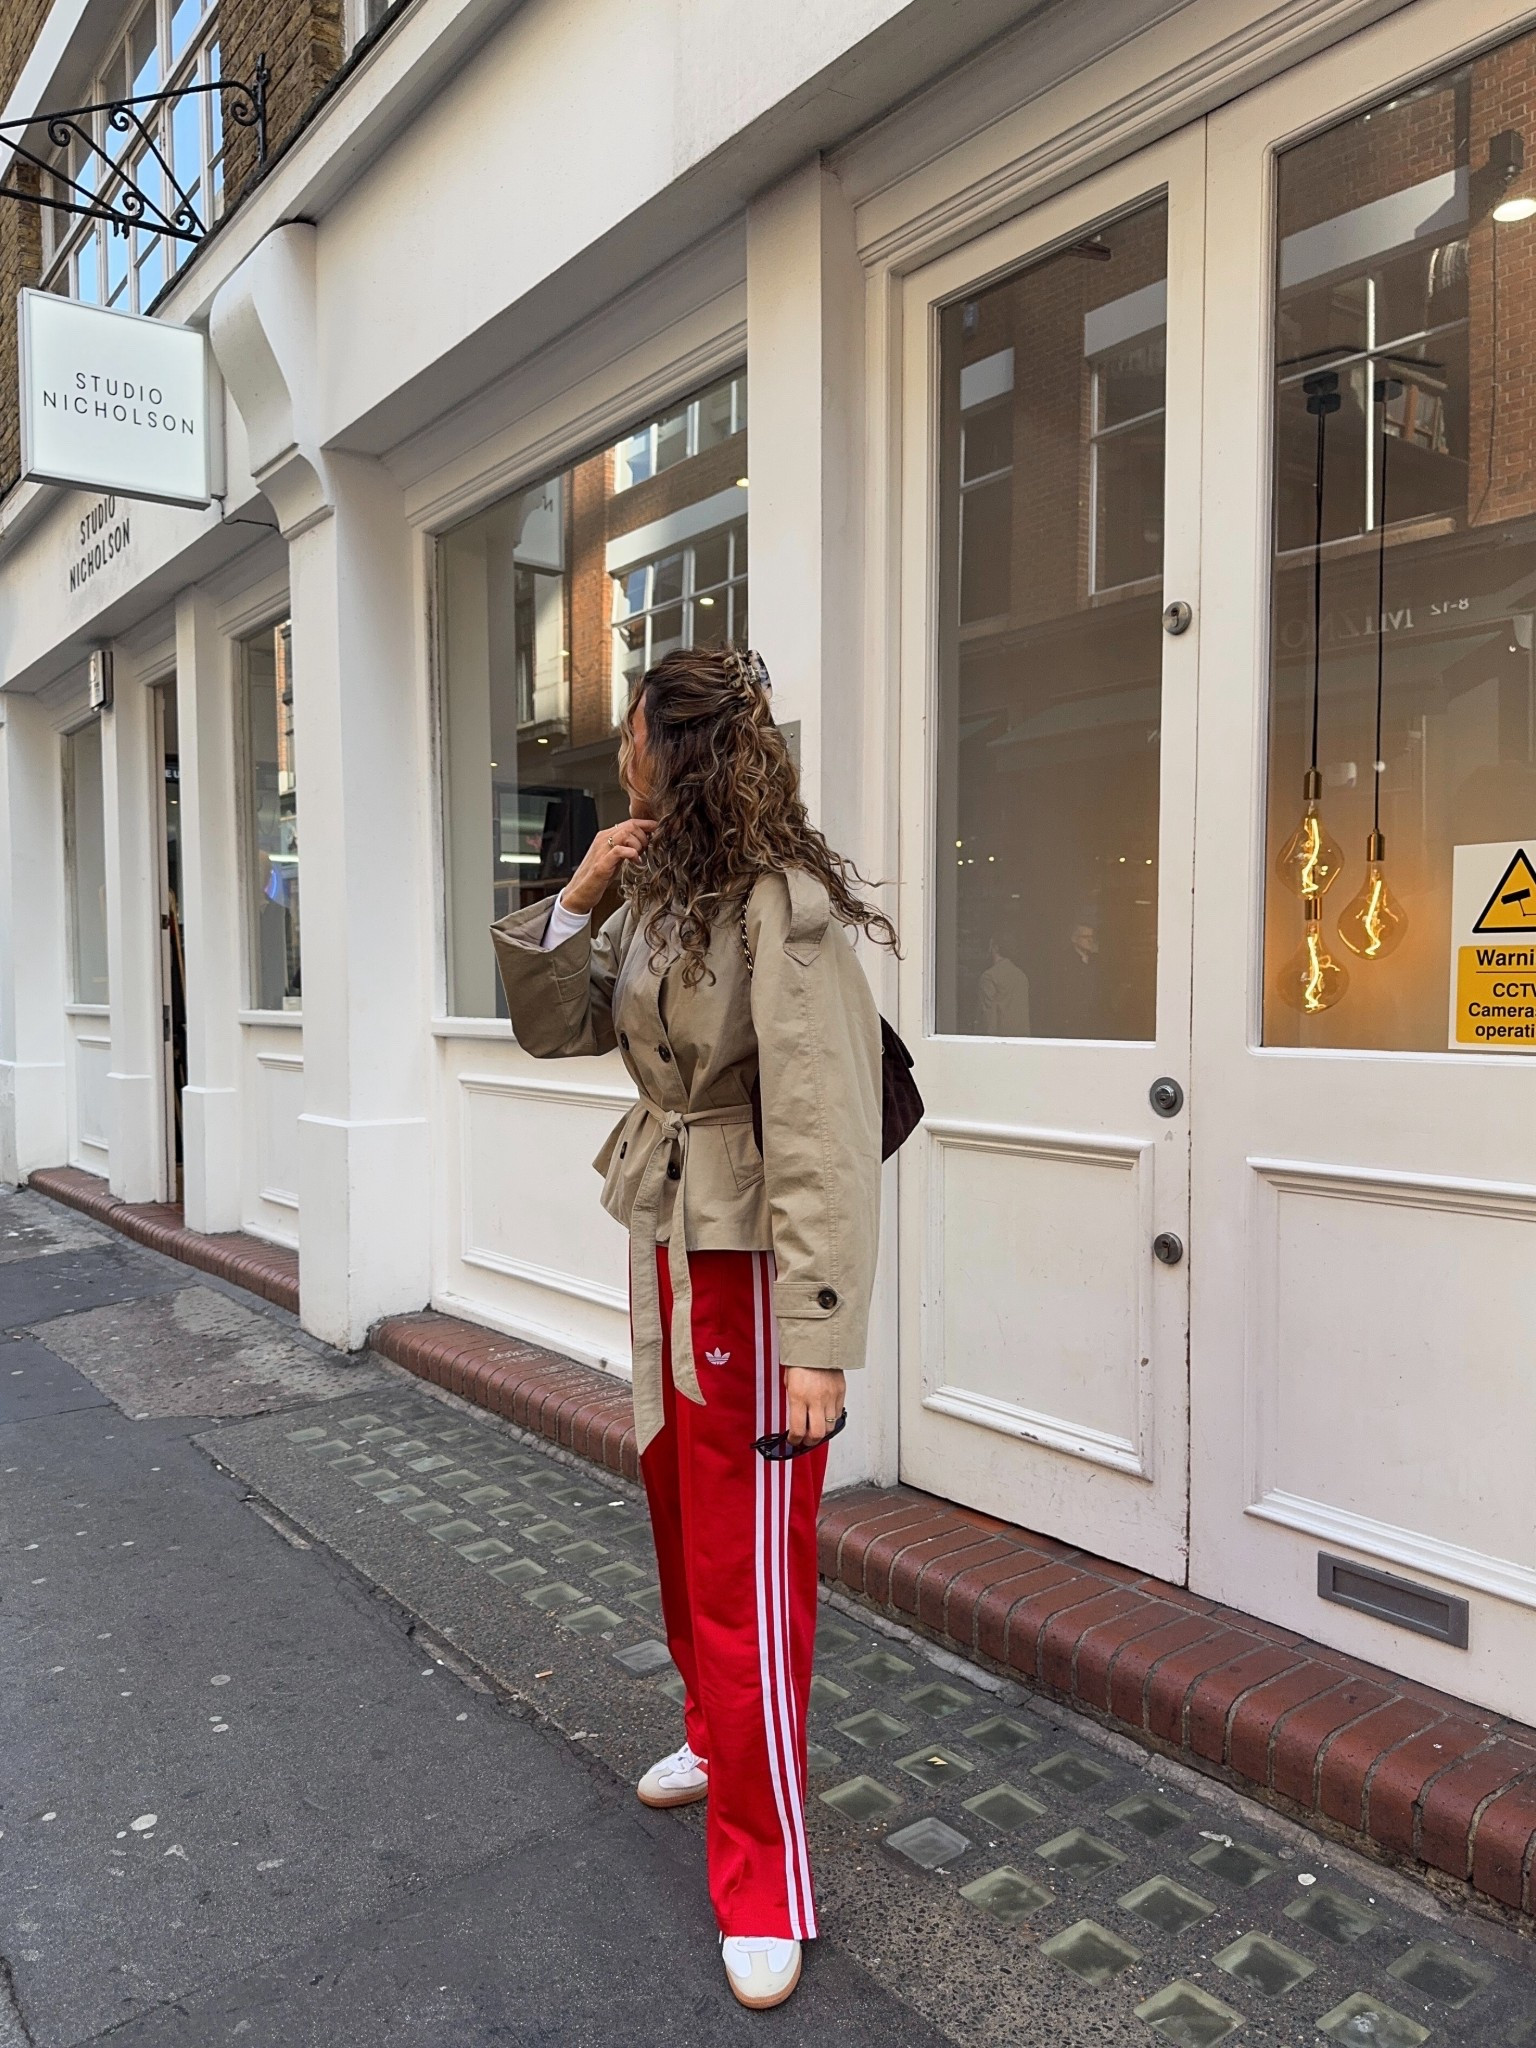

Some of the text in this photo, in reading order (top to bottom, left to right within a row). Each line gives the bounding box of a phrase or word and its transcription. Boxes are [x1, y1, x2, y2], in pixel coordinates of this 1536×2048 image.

[76, 372, 163, 405] STUDIO
[43, 390, 194, 435] NICHOLSON
[80, 495, 116, 545] STUDIO
[69, 517, 131, 593] NICHOLSON
[1468, 1002, 1536, 1018] Camera
